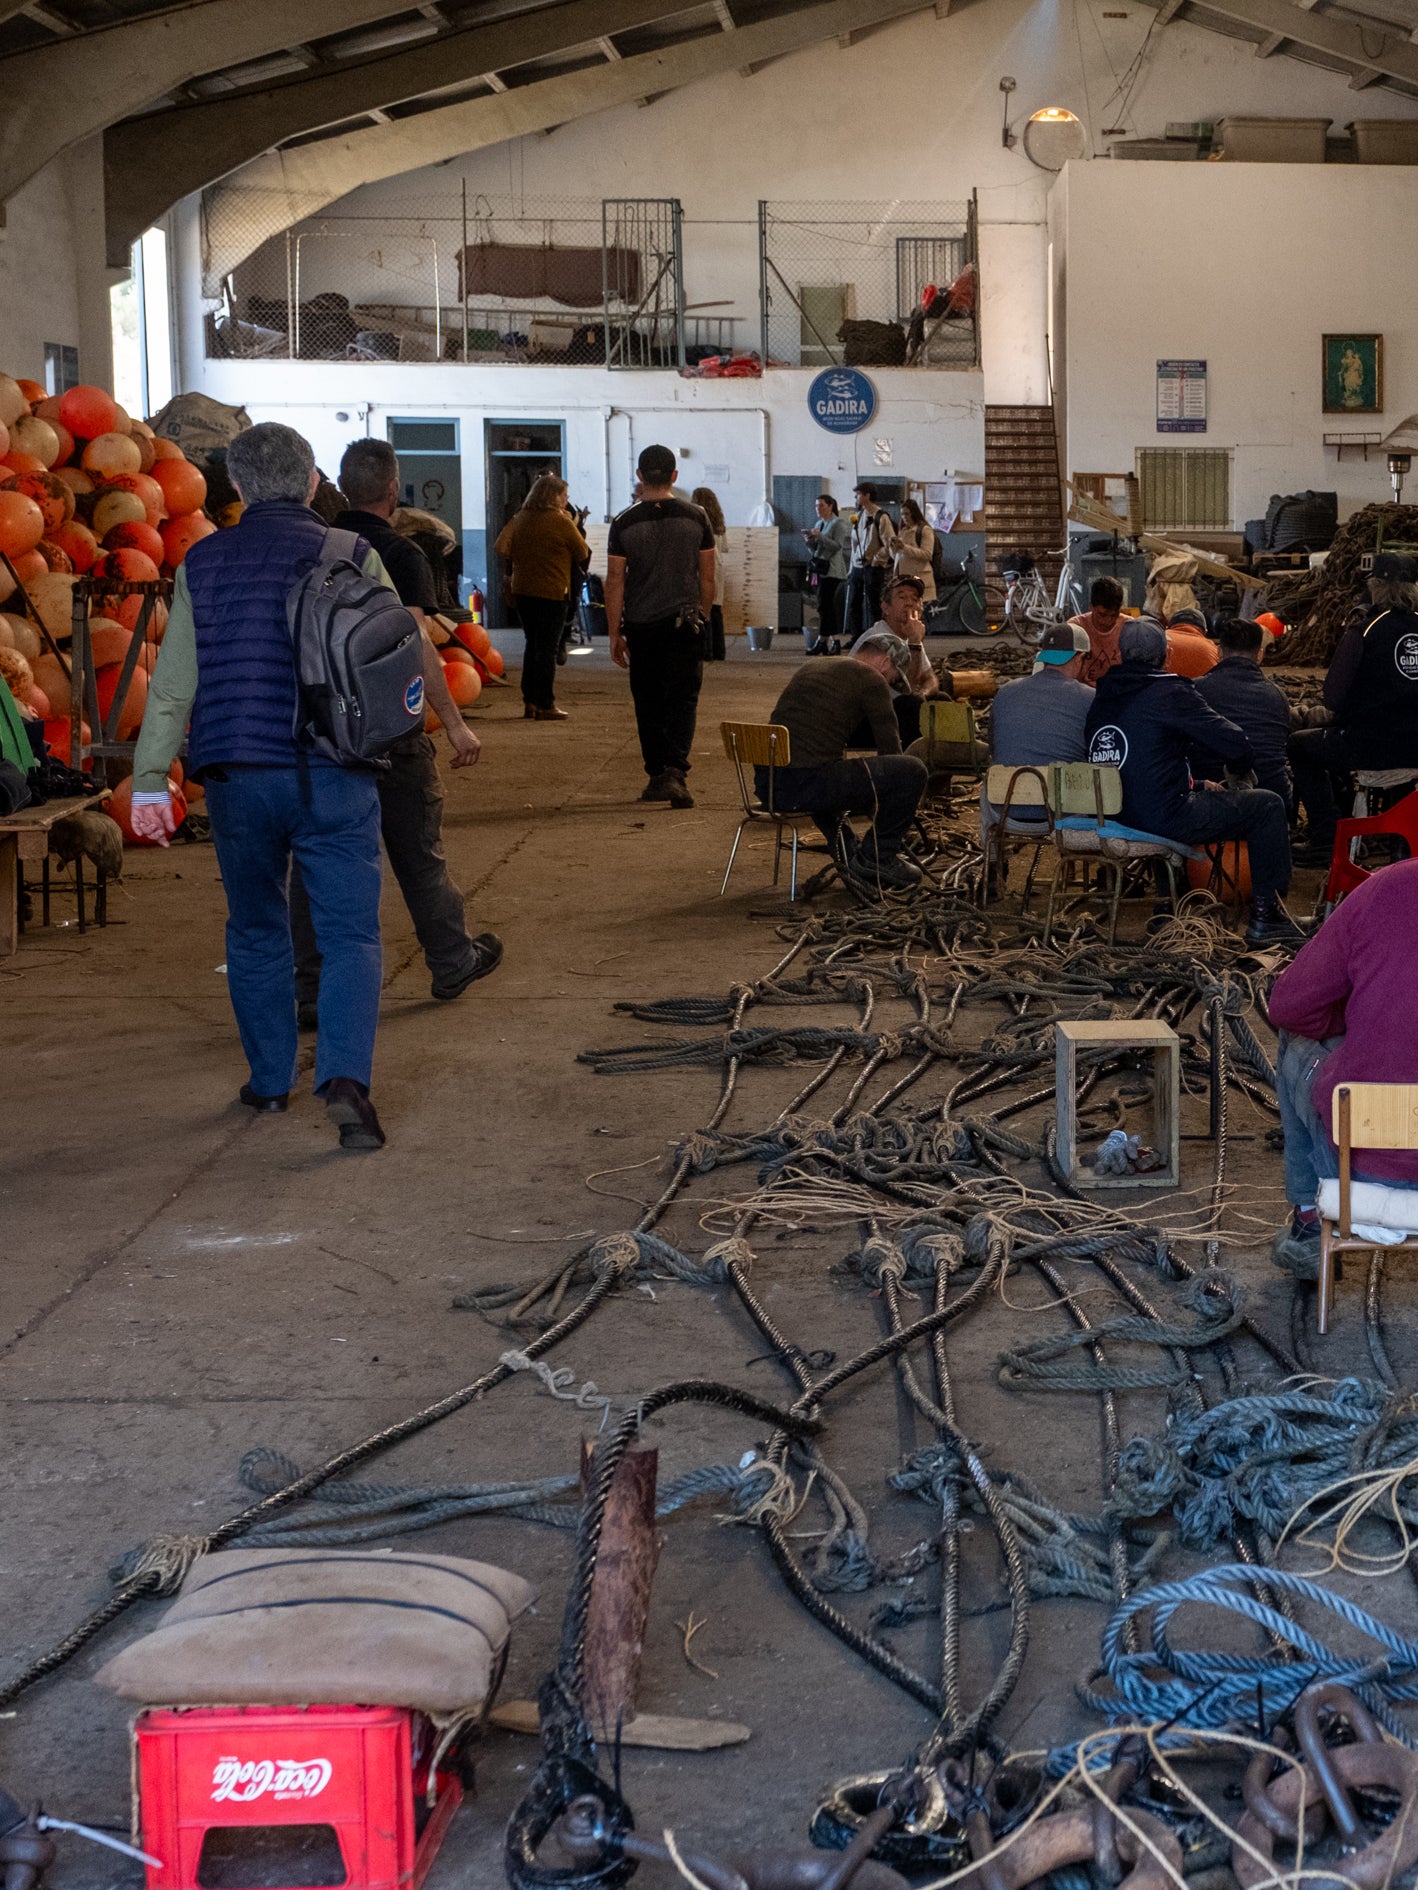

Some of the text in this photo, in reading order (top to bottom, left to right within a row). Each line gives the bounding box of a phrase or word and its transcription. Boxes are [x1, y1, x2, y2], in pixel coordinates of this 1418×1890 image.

[816, 400, 868, 415] GADIRA
[1092, 749, 1121, 763] GADIRA
[209, 1758, 333, 1802] Coca-Cola
